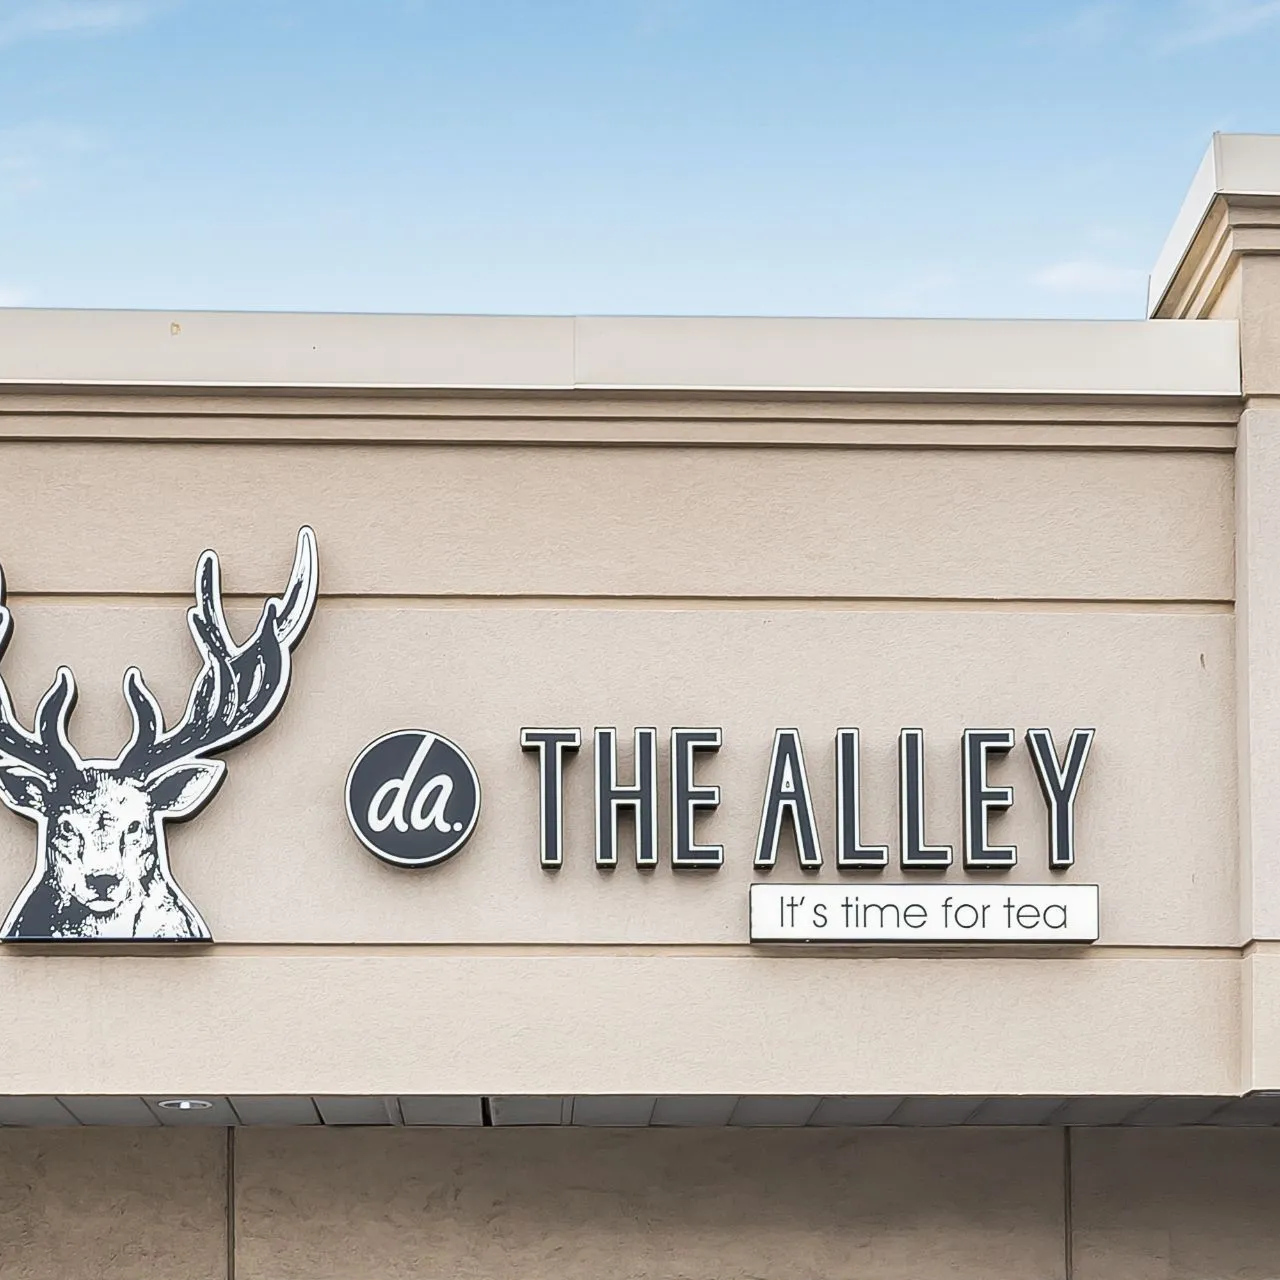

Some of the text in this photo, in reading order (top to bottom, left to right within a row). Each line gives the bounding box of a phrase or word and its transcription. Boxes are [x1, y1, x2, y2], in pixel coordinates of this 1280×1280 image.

[519, 726, 1097, 872] THE ALLEY
[778, 896, 1069, 931] It's time for tea
